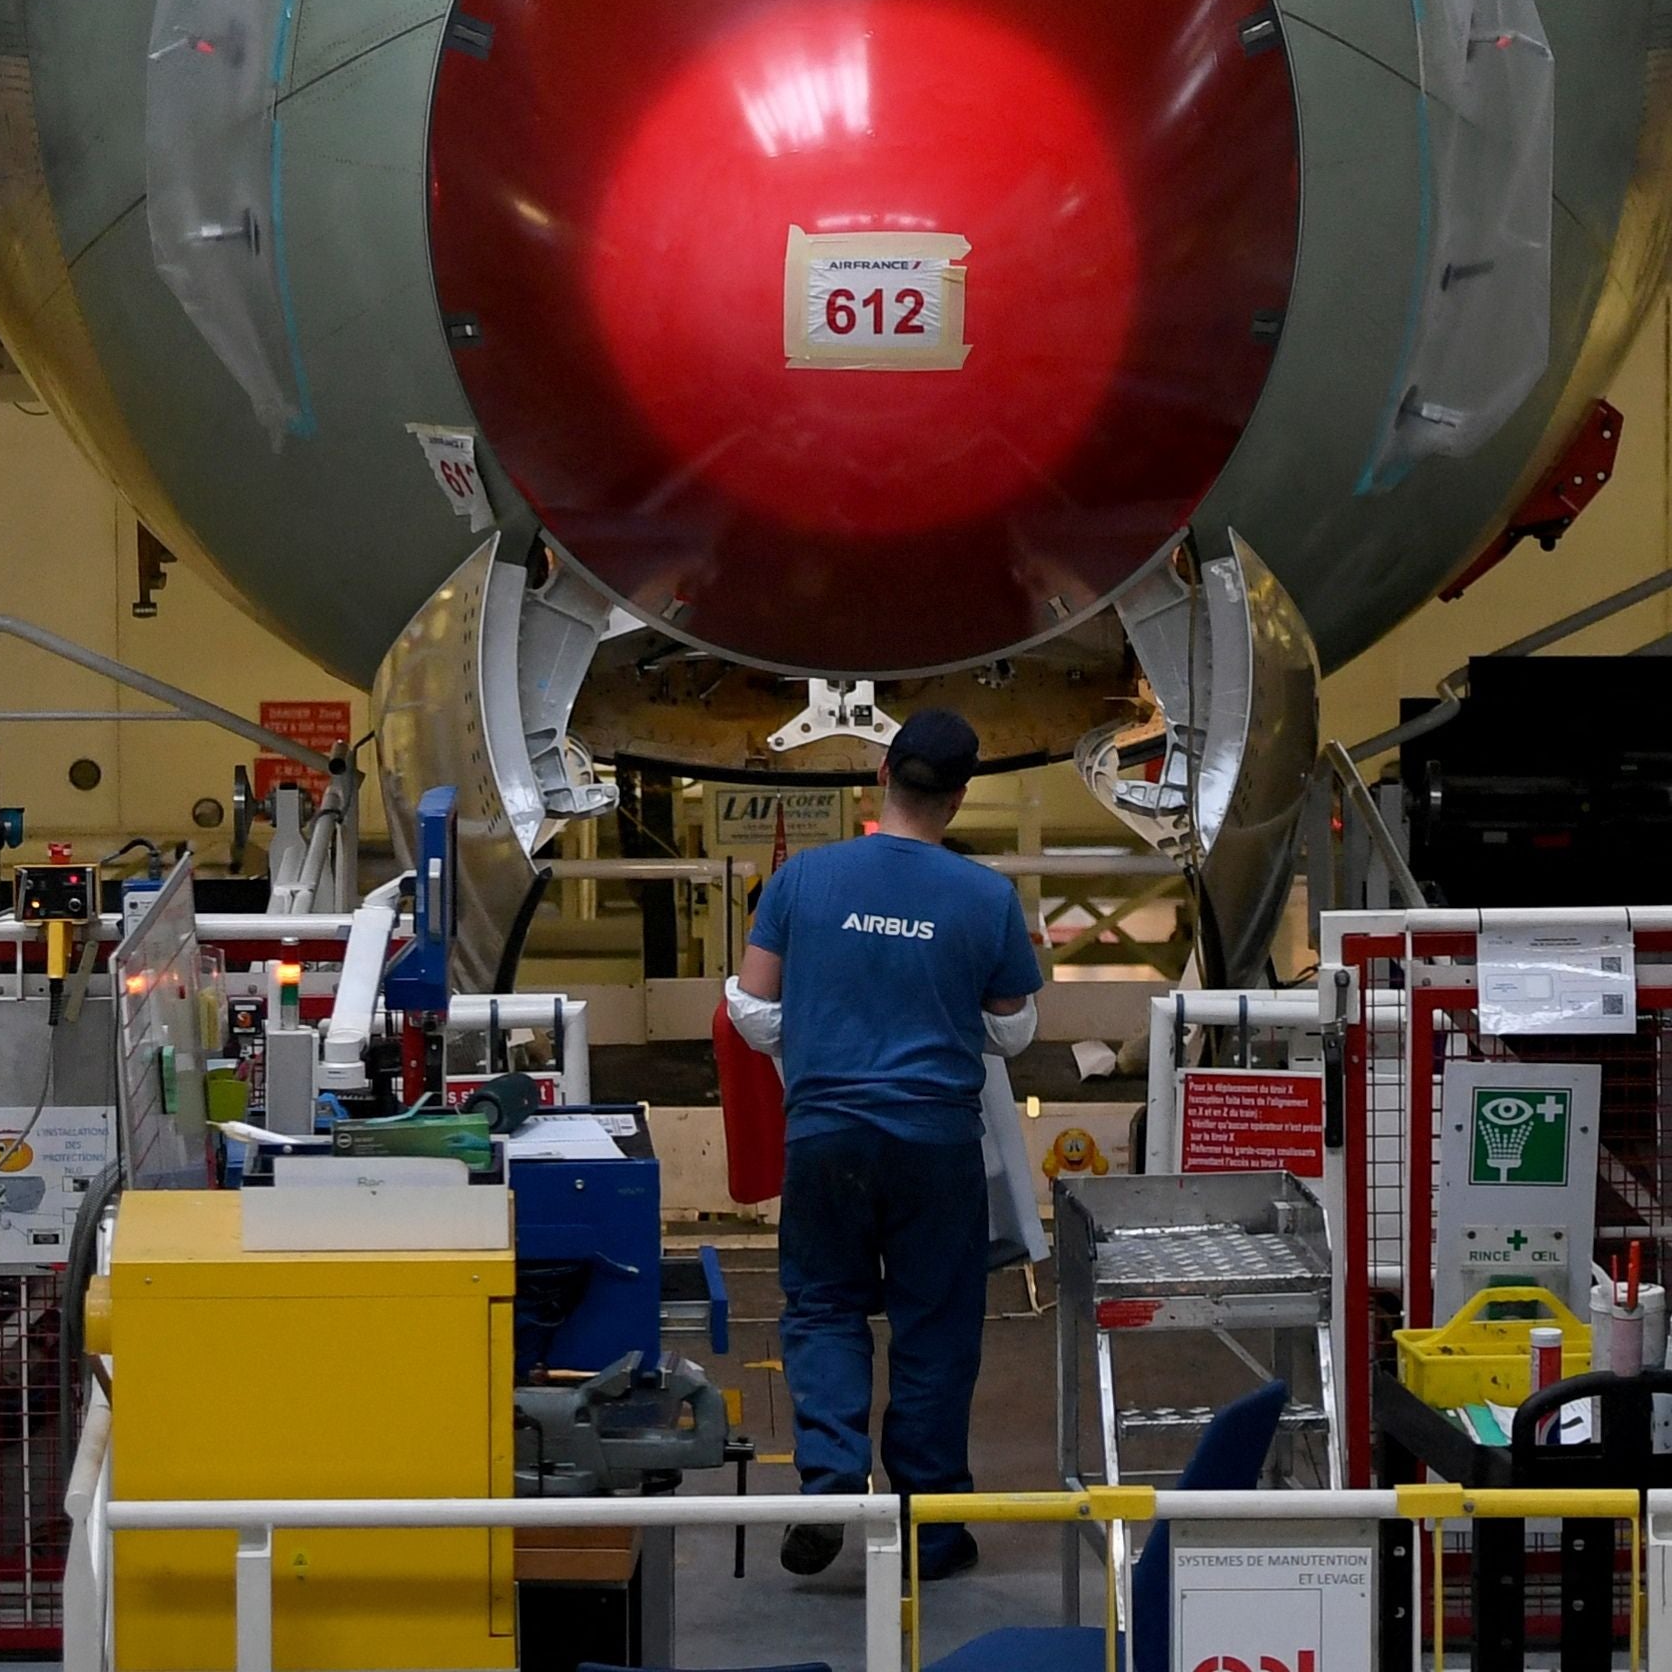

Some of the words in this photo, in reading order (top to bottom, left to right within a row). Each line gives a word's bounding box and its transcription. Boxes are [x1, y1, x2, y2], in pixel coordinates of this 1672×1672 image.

[829, 260, 909, 270] AIRFRANCE
[826, 288, 925, 335] 612
[723, 794, 836, 820] LATCOERE
[841, 913, 935, 940] AIRBUS
[1189, 1082, 1205, 1092] Pour
[1207, 1083, 1213, 1092] le
[1259, 1084, 1269, 1093] du
[1288, 1085, 1294, 1094] X
[1226, 1095, 1240, 1104] faite
[1241, 1096, 1255, 1105] lors
[1256, 1096, 1265, 1105] de
[1188, 1108, 1197, 1116] en
[1204, 1108, 1212, 1116] et
[1213, 1108, 1221, 1116] en
[1229, 1133, 1235, 1141] X
[64, 1140, 82, 1150] DES
[1278, 1159, 1284, 1168] X
[1469, 1250, 1511, 1262] RINCE
[1531, 1250, 1560, 1262] ŒIL
[1178, 1555, 1243, 1567] SYSTEMES
[1247, 1555, 1263, 1566] DE
[1268, 1555, 1368, 1566] MANUTENTION
[1299, 1573, 1313, 1584] ET
[1318, 1573, 1366, 1585] LEVAGE
